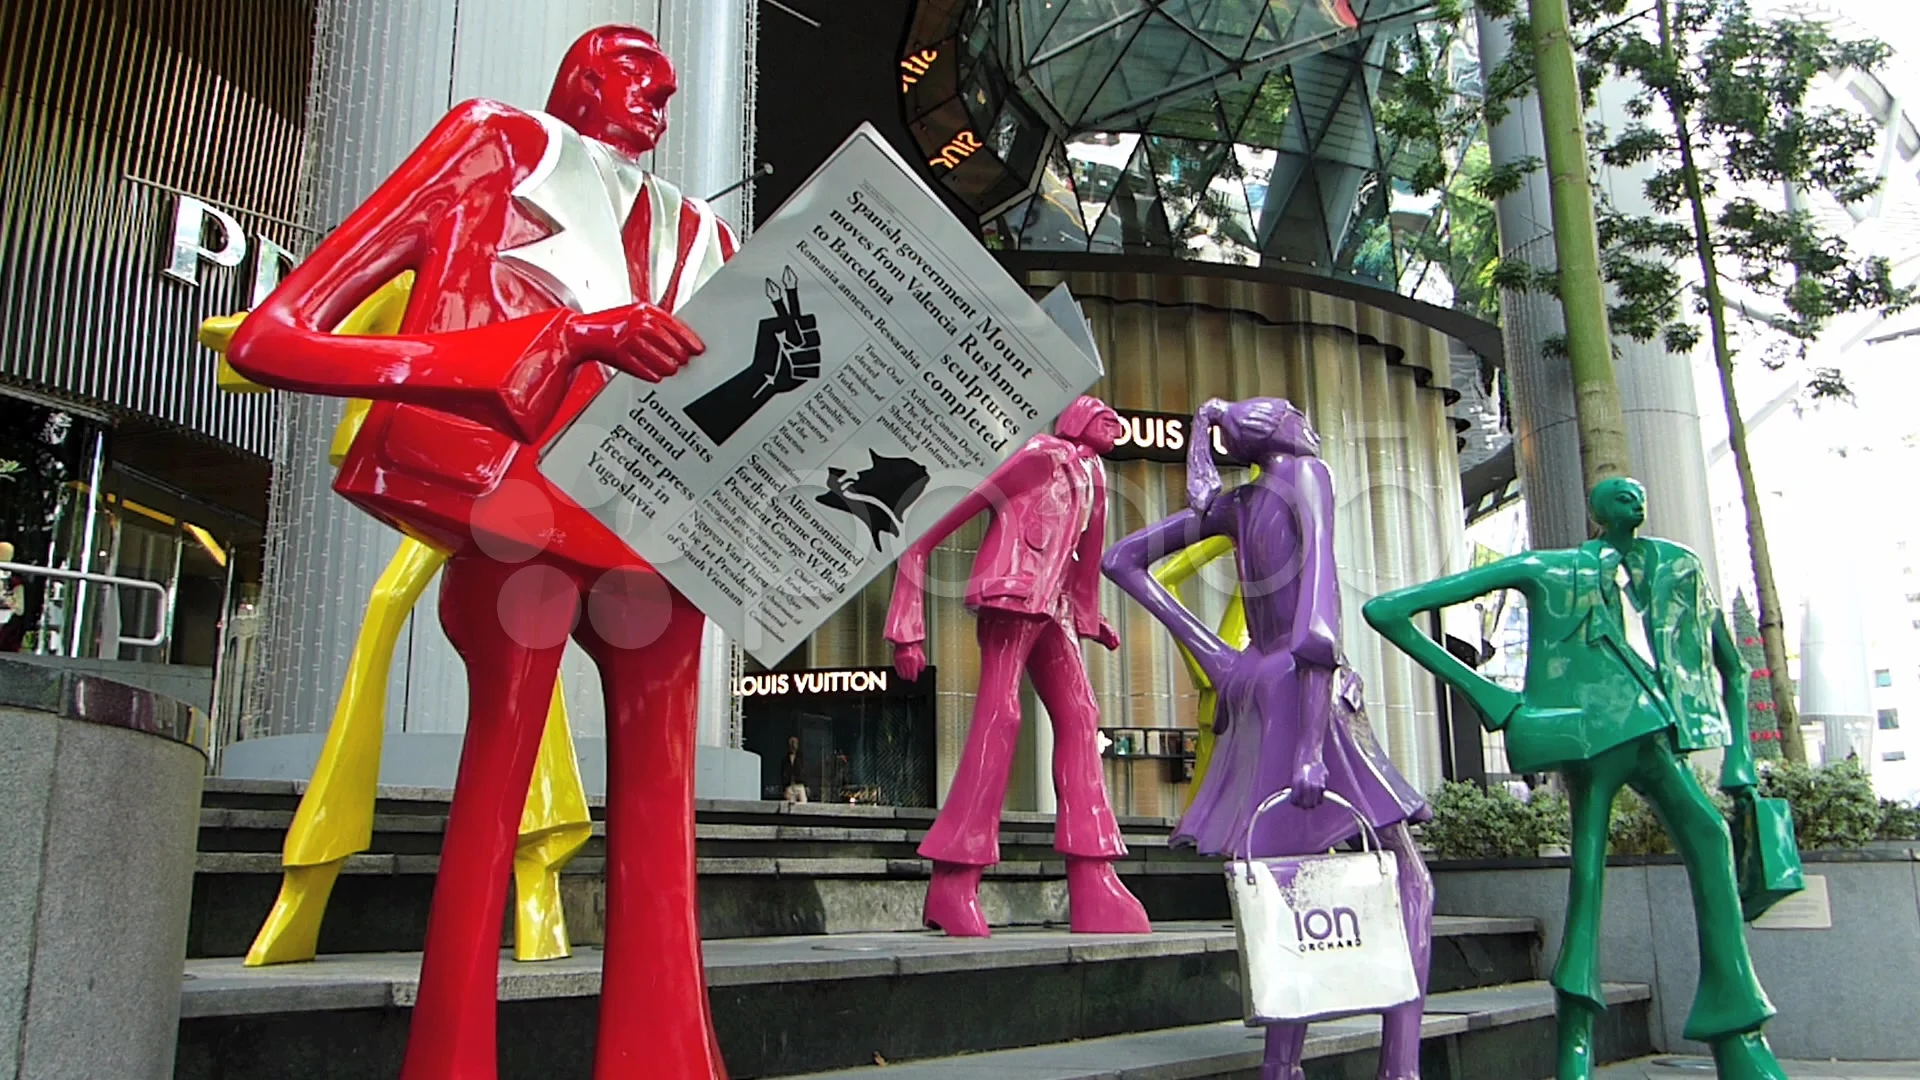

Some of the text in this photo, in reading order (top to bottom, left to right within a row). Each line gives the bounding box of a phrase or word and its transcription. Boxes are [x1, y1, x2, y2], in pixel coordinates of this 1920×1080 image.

[812, 224, 894, 305] to Barcelona
[829, 209, 958, 336] moves from Valencia
[846, 190, 902, 251] Spanish
[895, 242, 976, 319] government
[795, 239, 921, 370] Romania annexes Bessarabia
[842, 363, 886, 402] president of
[957, 332, 1038, 420] Rushmore
[975, 315, 1032, 379] Mount
[813, 391, 846, 426] Republic
[821, 383, 862, 426] Dominican
[836, 370, 859, 397] Turkey
[906, 388, 934, 416] Arthur
[933, 413, 958, 442] Conan
[922, 371, 1009, 453] completed
[940, 354, 1020, 441] sculptures
[628, 407, 686, 461] demand
[637, 389, 713, 463] Journalists
[875, 415, 918, 453] published
[888, 404, 922, 441] Sherlock
[916, 417, 959, 460] Adventures
[958, 454, 972, 468] of
[587, 450, 656, 519] Yugoslavia
[598, 433, 670, 505] freedom in
[609, 424, 695, 500] greater press
[688, 509, 725, 547] Nguyen
[724, 541, 742, 563] Van
[711, 488, 783, 559] Polish government
[723, 475, 846, 594] President George W. Bush
[734, 465, 851, 578] for the Supreme Court by
[746, 453, 864, 567] Samuel Alito nominated
[666, 533, 743, 607] of South Vietnam
[677, 522, 689, 534] to
[687, 530, 701, 546] be
[714, 555, 757, 598] President
[741, 535, 781, 574] Solidarity
[731, 671, 887, 697] LOUIS VUITTON
[1298, 938, 1362, 953] ORCHARD
